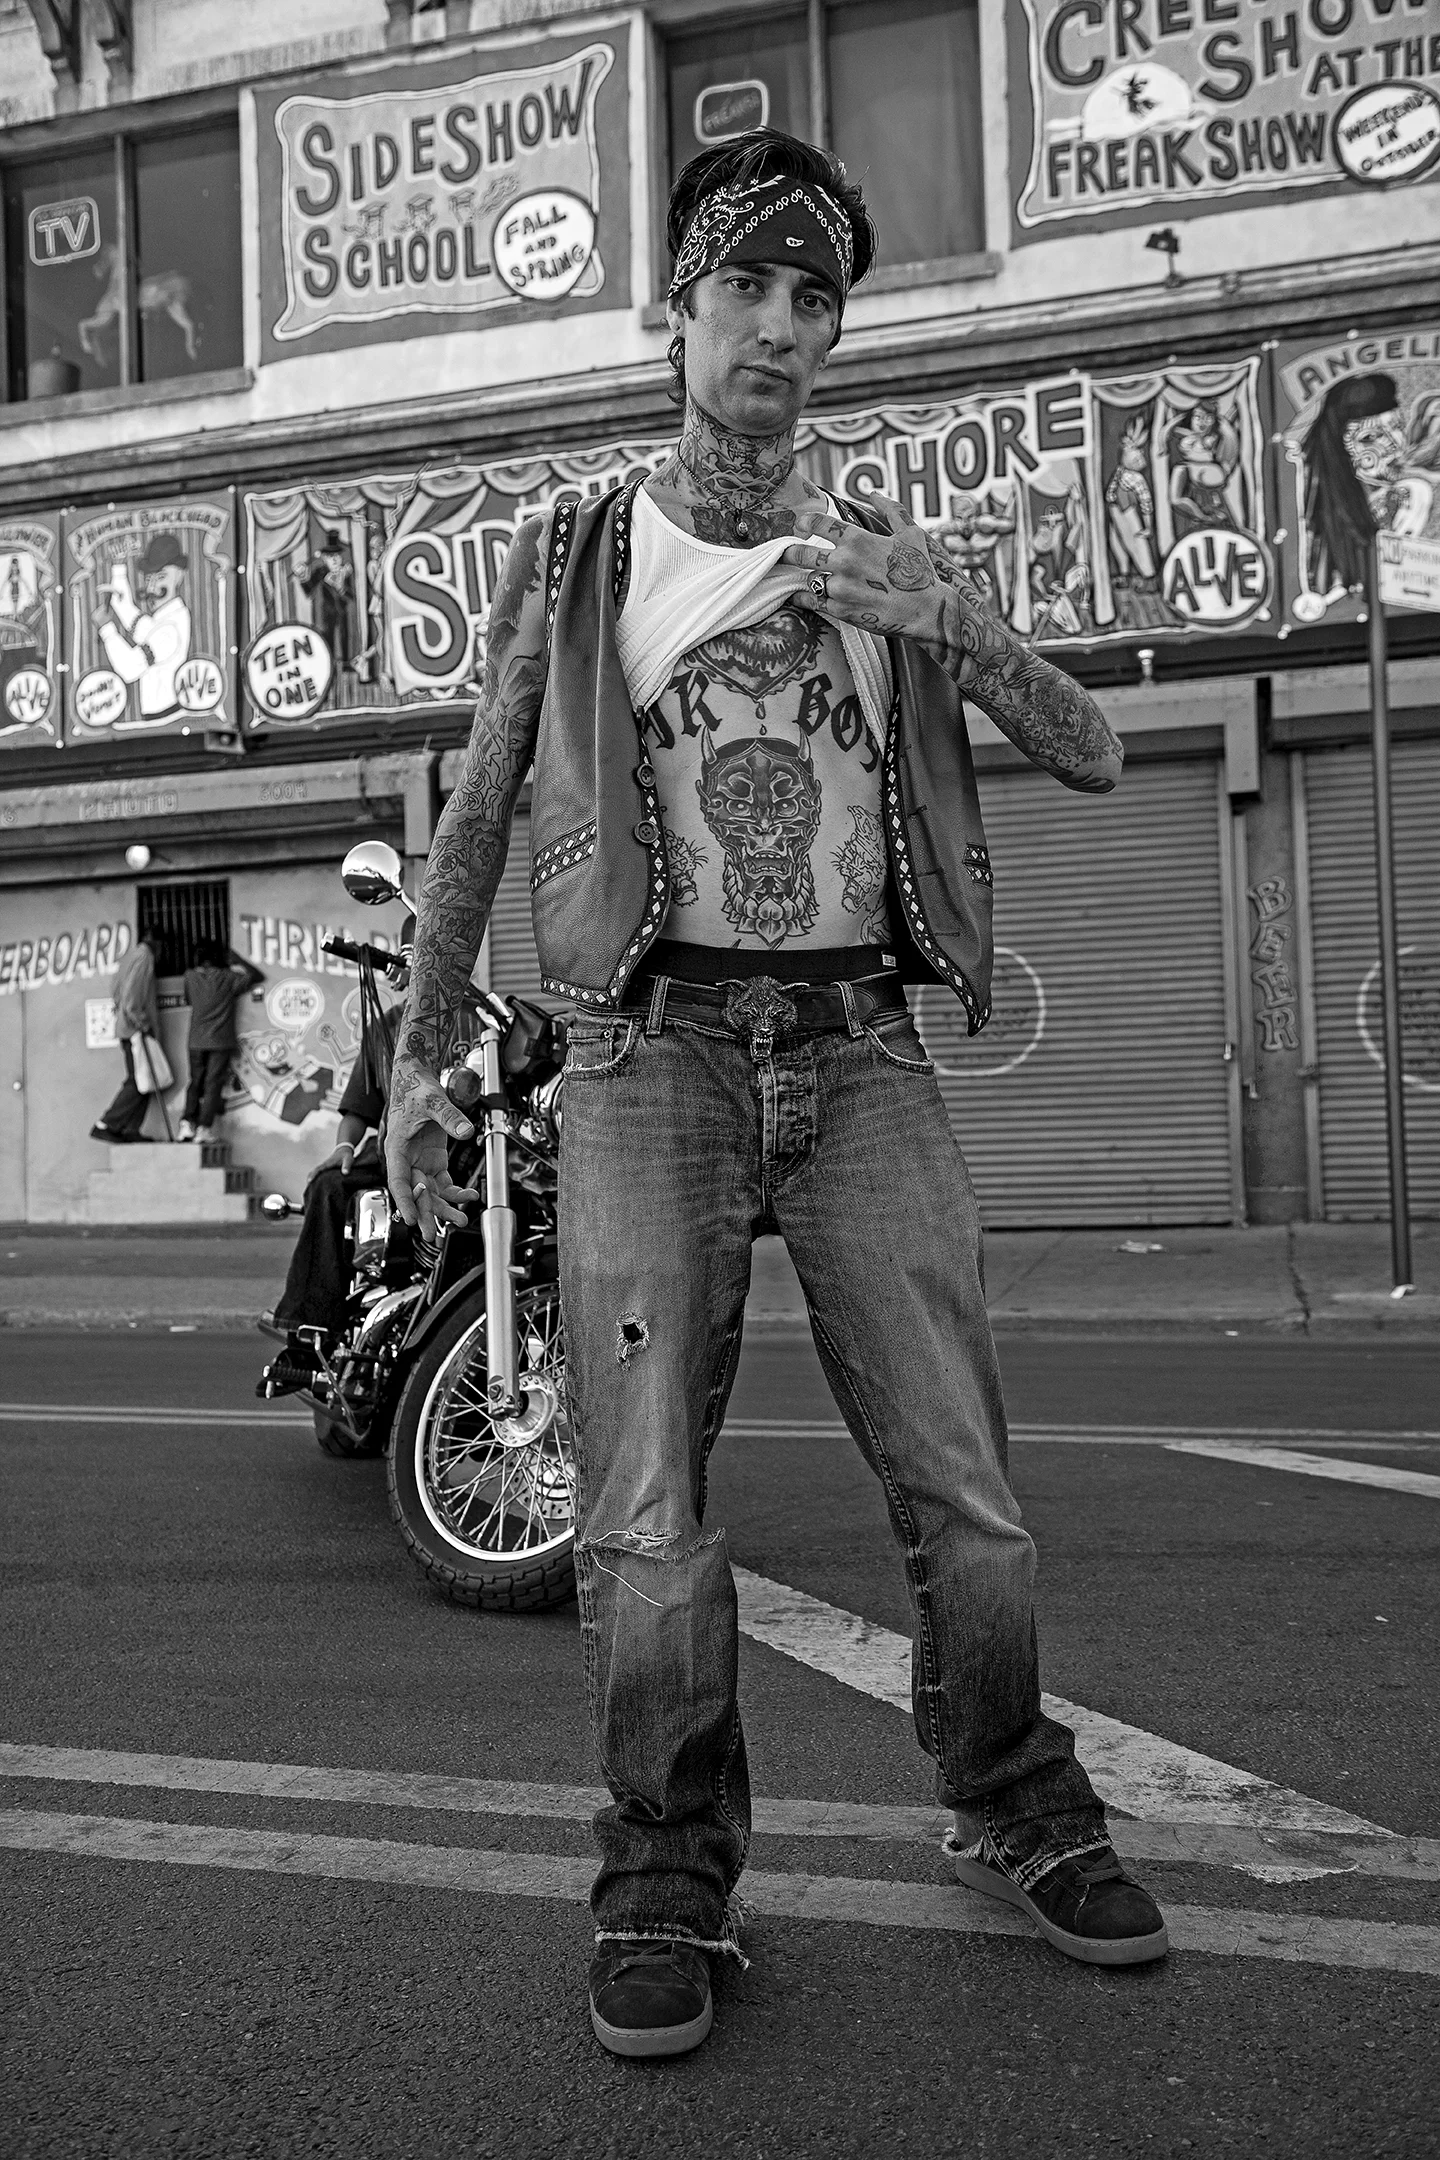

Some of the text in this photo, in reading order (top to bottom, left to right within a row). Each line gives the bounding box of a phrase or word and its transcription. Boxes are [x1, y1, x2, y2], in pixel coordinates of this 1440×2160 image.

[1046, 0, 1242, 86] CRE
[1200, 0, 1426, 102] SHO
[1309, 48, 1363, 95] AT
[296, 58, 594, 217] SIDESHOW
[35, 211, 91, 258] TV
[505, 205, 567, 245] FALL
[525, 236, 557, 254] AND
[303, 224, 491, 298] SCHOOL
[510, 244, 584, 287] SPRING
[1168, 536, 1260, 612] ALIVE
[254, 635, 313, 672] TEN
[278, 666, 301, 682] IN
[8, 677, 50, 717] ALIVE
[177, 664, 217, 704] ALIVE
[266, 677, 318, 709] ONE
[1247, 875, 1299, 1051] BEER
